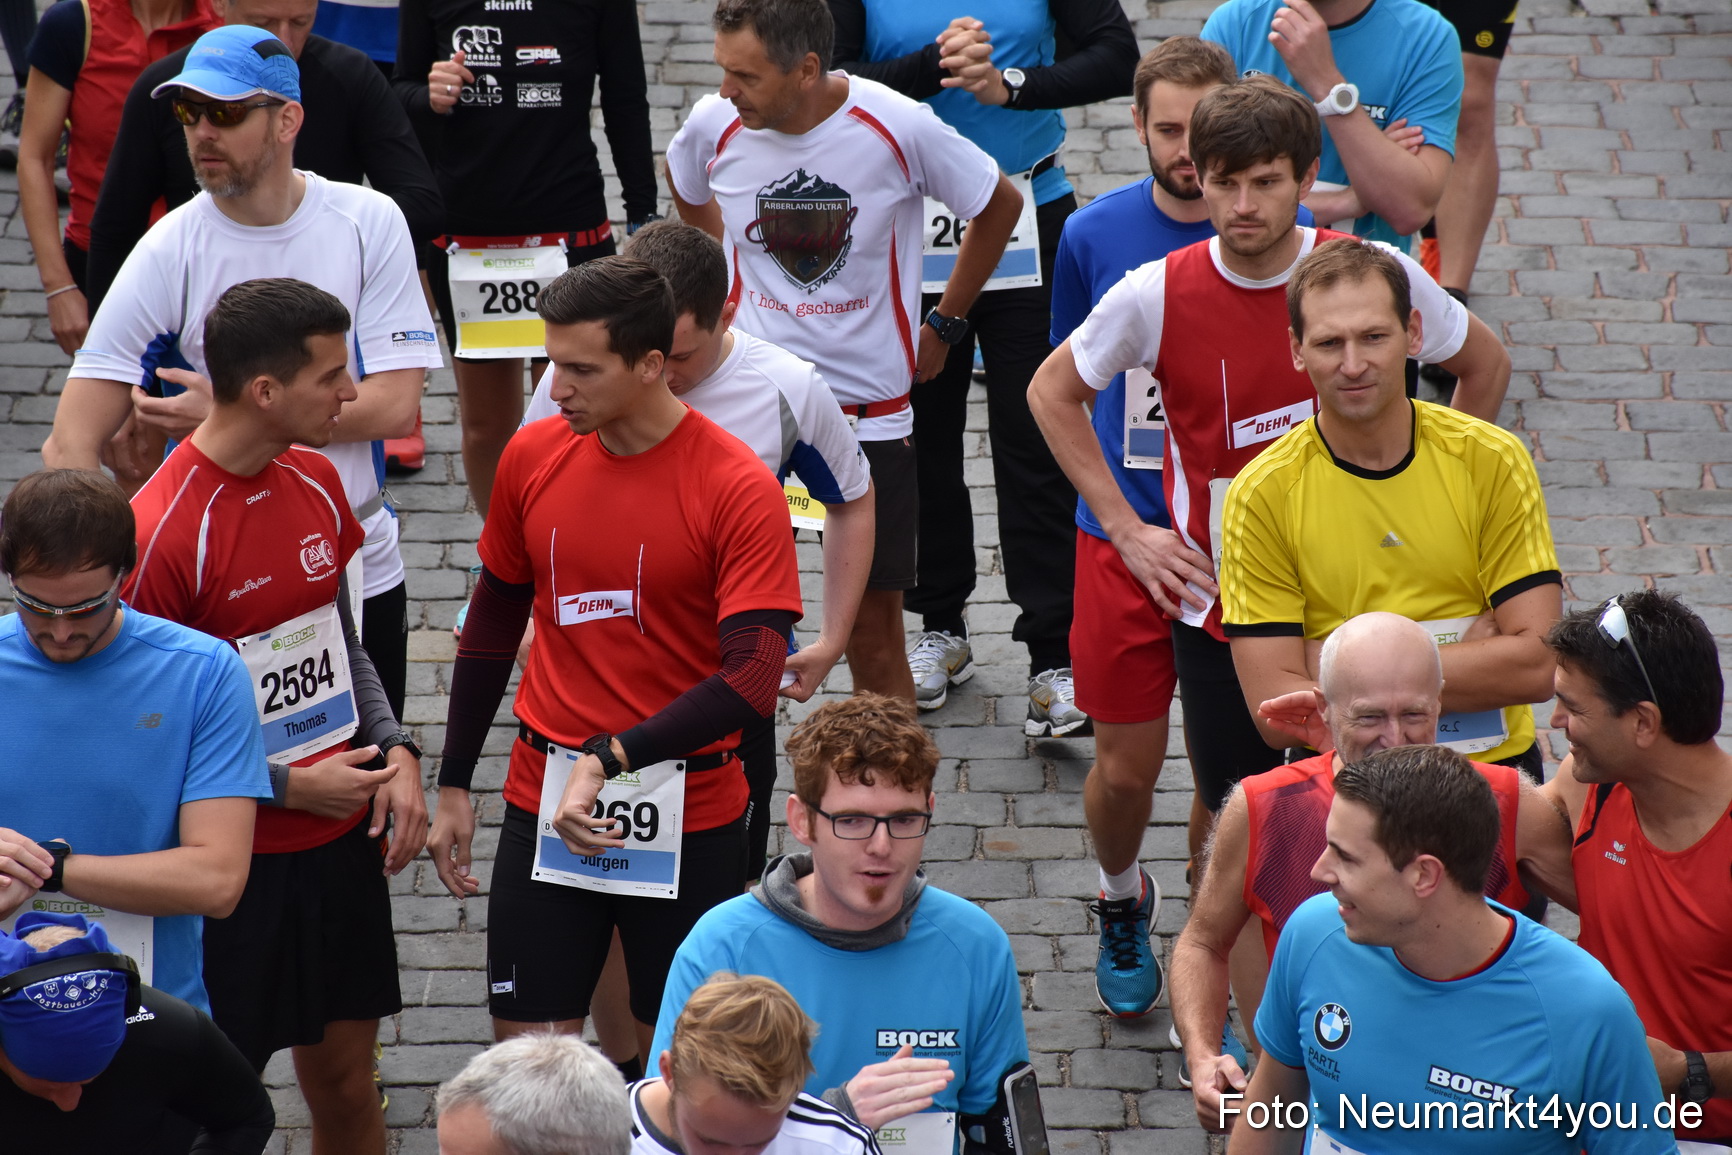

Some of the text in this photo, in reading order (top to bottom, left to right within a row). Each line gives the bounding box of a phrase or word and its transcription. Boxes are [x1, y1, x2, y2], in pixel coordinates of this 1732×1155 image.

[484, 0, 533, 11] skinfit
[516, 48, 561, 60] GREIL
[517, 87, 562, 102] ROCK
[764, 201, 843, 211] ARBERLAND ULTRA
[495, 258, 536, 269] BOCK
[815, 258, 847, 289] VIKING
[479, 280, 541, 315] 288
[795, 295, 870, 317] gschafft!
[1255, 413, 1292, 435] DEHN
[246, 490, 267, 505] CRAFT
[577, 598, 613, 615] DEHN
[284, 624, 317, 648] BOCK
[260, 648, 335, 716] 2584
[283, 711, 328, 738] Thomas
[49, 900, 104, 913] BOCK
[876, 1029, 960, 1048] BOCK
[933, 1050, 962, 1058] concepts
[1308, 1046, 1341, 1074] PARTL
[1308, 1056, 1340, 1082] Neumarkt
[1428, 1065, 1518, 1106] BOCK
[1003, 1116, 1015, 1149] runtastic
